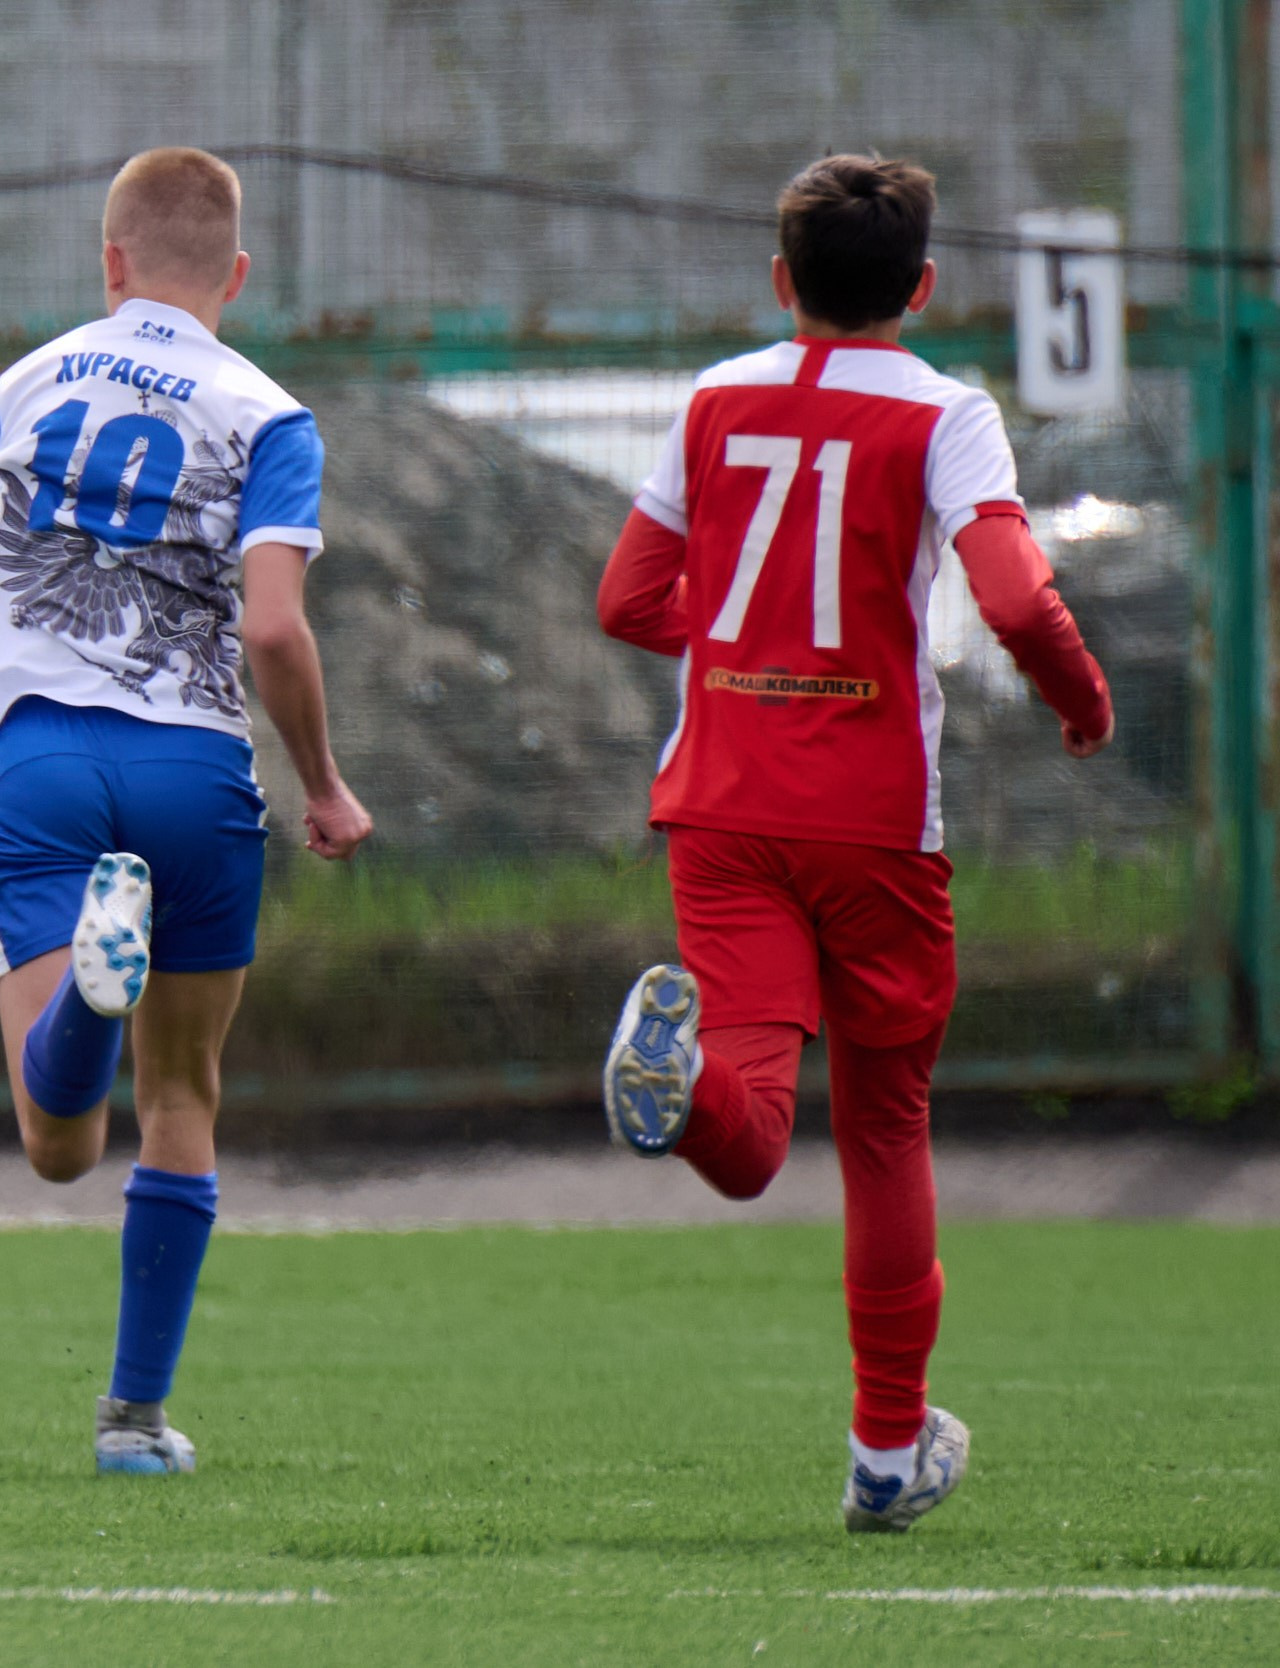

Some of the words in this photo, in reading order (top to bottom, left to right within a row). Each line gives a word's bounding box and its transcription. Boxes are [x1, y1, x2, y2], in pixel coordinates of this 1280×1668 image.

[1044, 245, 1090, 376] 5
[28, 399, 184, 547] 10
[708, 434, 853, 648] 71
